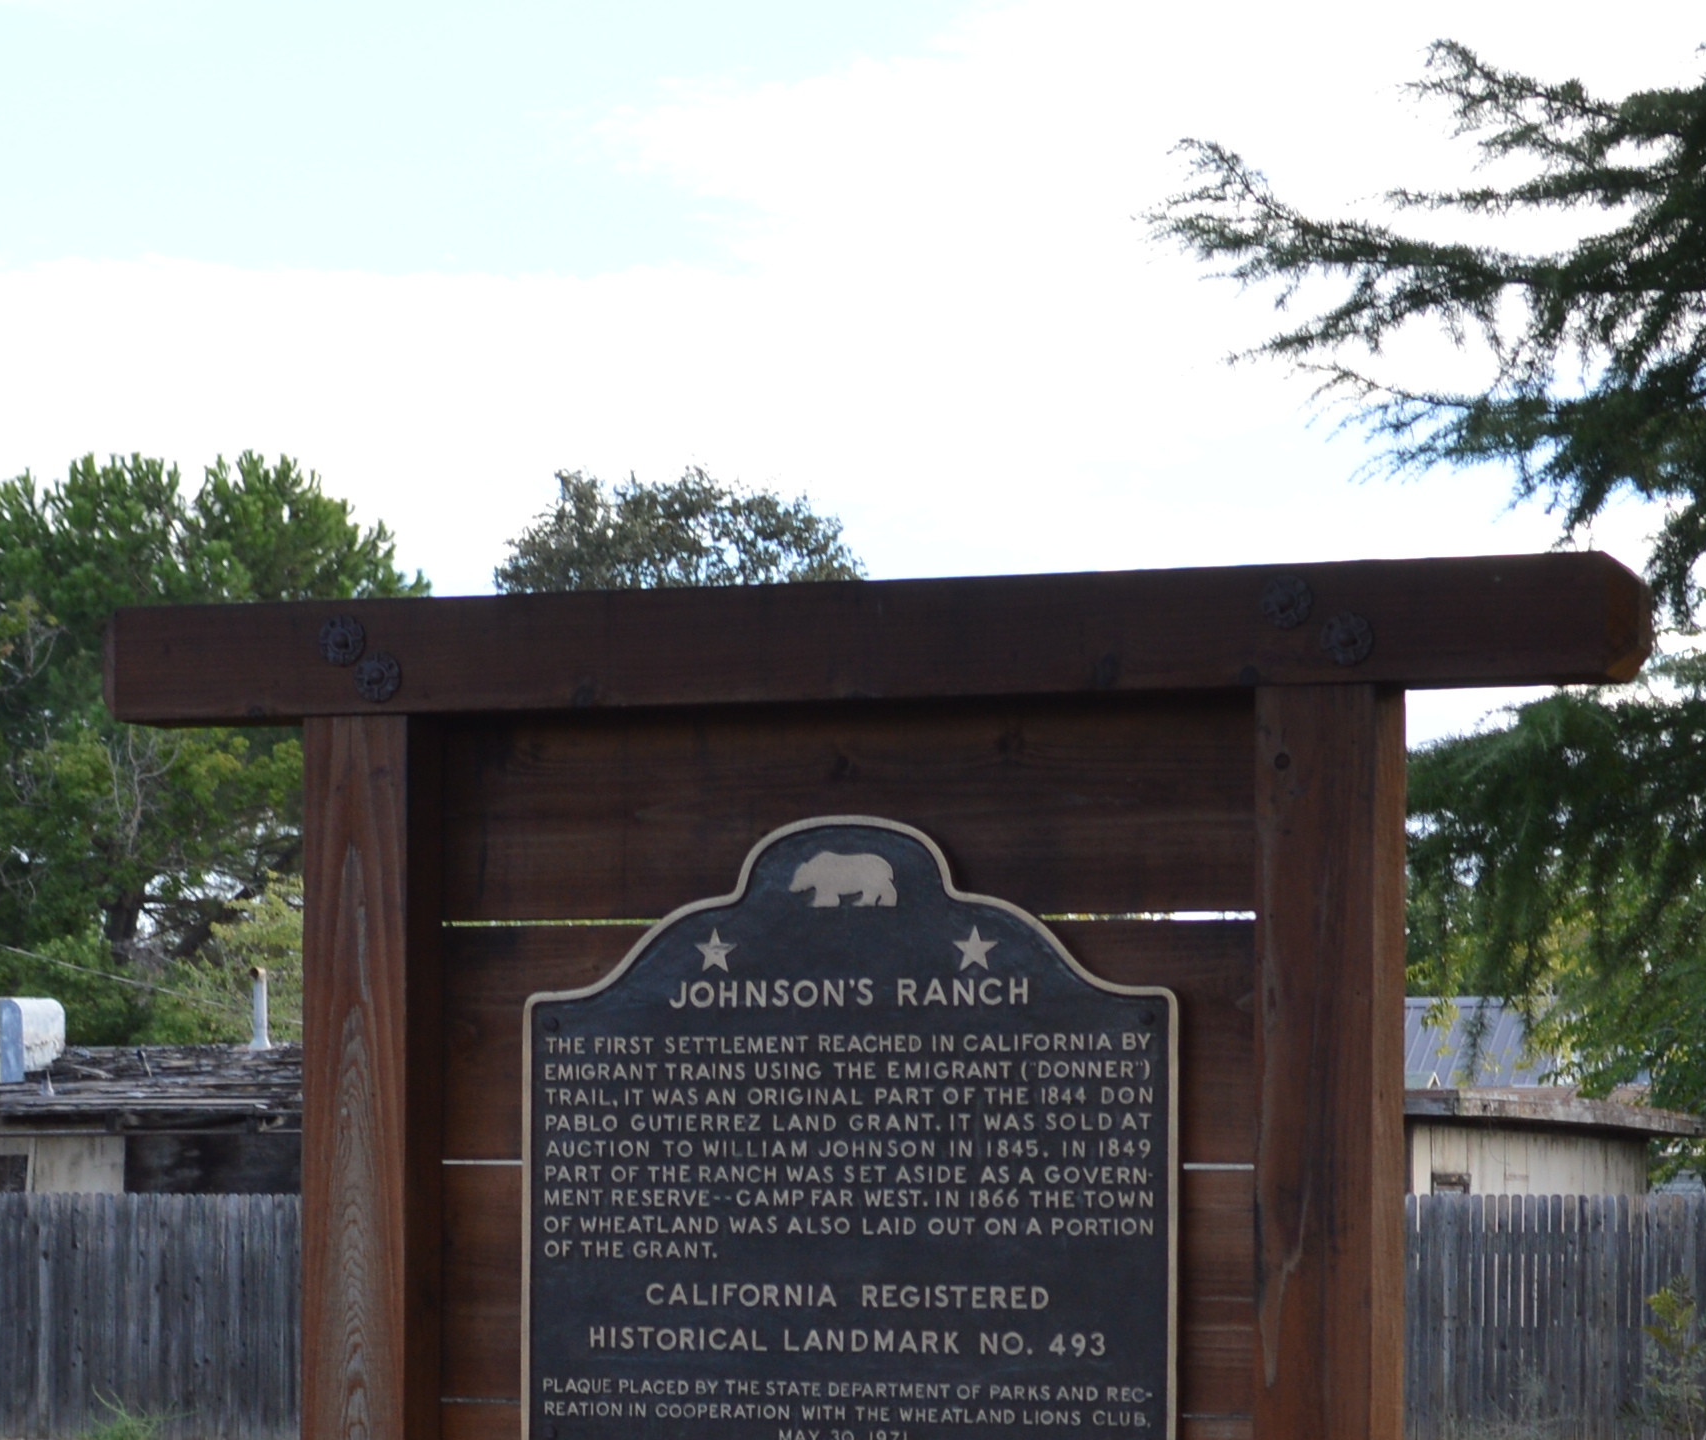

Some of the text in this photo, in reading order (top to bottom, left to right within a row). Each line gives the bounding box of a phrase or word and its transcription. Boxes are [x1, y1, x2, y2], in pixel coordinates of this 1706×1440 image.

[669, 976, 1028, 1009] JOHNSON'S RANCH
[545, 1032, 1151, 1054] THE FIRST SETTLEMENT REACHED IN CALIFORNIA BY
[545, 1062, 657, 1081] EMIGRANT
[665, 1062, 745, 1081] TRAINS
[755, 1061, 821, 1080] USING
[833, 1061, 876, 1079] THE
[887, 1060, 1012, 1080] EMIGRANT
[625, 1088, 644, 1106] IT
[652, 1087, 698, 1106] WAS
[705, 1088, 736, 1105] AN
[747, 1087, 863, 1105] ORIGINAL
[875, 1087, 934, 1105] PART
[942, 1086, 975, 1105] OF
[984, 1086, 1029, 1105] THE
[1041, 1084, 1086, 1105] 1844
[1101, 1086, 1153, 1104] DON
[545, 1112, 1152, 1132] PABLO GUTIERREZ LAND GRANT. IT WAS SOLD AT
[546, 1137, 1151, 1159] AUCTION TO WILLIAM JOHNSON IN 1845. IN 1849
[545, 1164, 1153, 1184] PART OF THE RANCH WAS SET ASIDE AS A GOVERN-
[544, 1188, 603, 1206] MENT
[811, 1189, 853, 1207] FAR
[864, 1188, 928, 1207] WEST.
[936, 1189, 959, 1207] IN
[970, 1188, 1019, 1208] 1866
[1029, 1189, 1075, 1208] THE
[1083, 1190, 1153, 1208] TOWN
[544, 1215, 1153, 1236] OF WHEATLAND WAS ALSO LAID OUT ON A PORTION
[544, 1239, 717, 1258] OF THE GRANT.
[646, 1282, 1049, 1310] CALIFORNIA REGISTERED
[590, 1326, 1105, 1357] HISTORICAL LANDMARK NO. 493
[543, 1377, 1152, 1403] PLAQUE PLACED BY THE STATE DEPARTMENT OF PARKS AND REC-
[544, 1400, 622, 1417] REATION
[629, 1402, 646, 1417] IN
[655, 1402, 790, 1420] COOPERATION
[801, 1405, 845, 1420] WITH
[855, 1406, 890, 1422] THE
[899, 1406, 1015, 1424] WHEATLAND
[1023, 1410, 1081, 1426] LIONS
